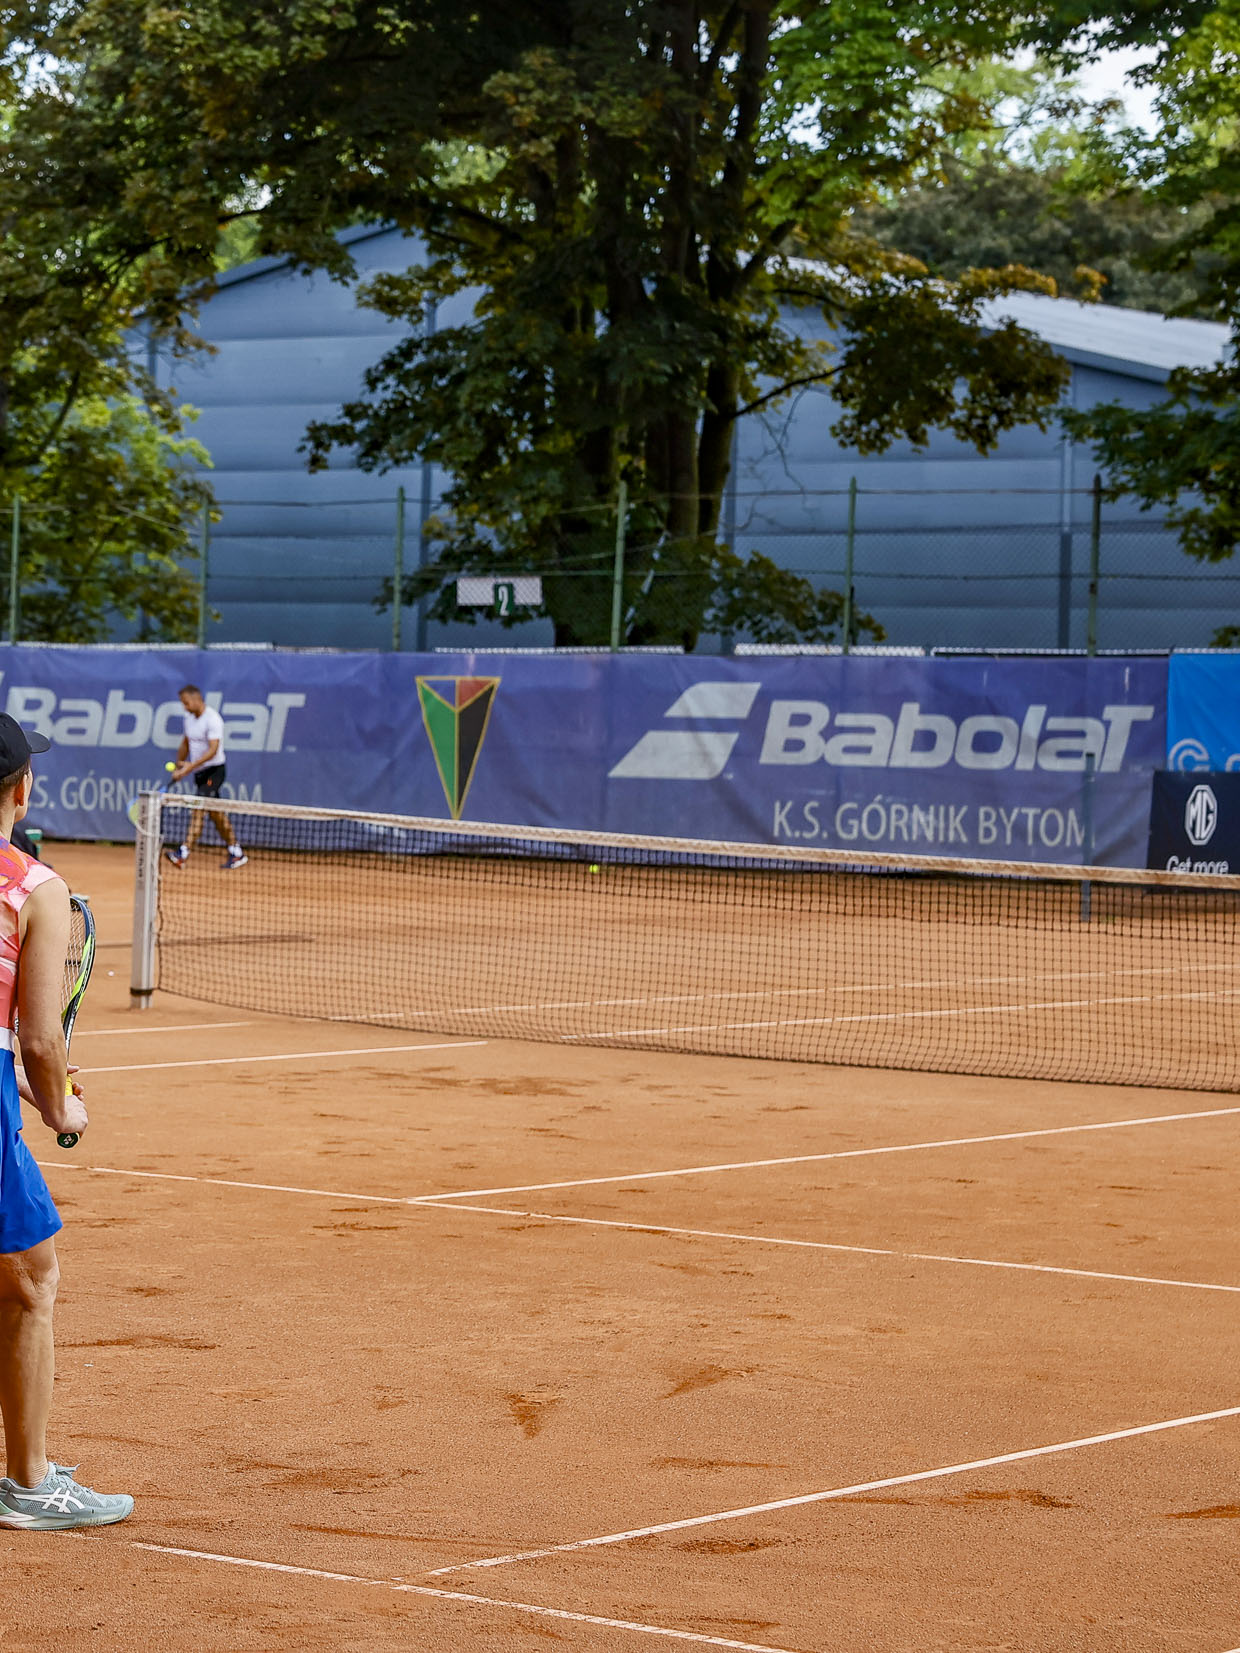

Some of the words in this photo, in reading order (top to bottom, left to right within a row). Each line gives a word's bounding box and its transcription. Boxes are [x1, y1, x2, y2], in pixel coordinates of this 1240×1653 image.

[498, 586, 509, 616] 2
[773, 800, 829, 839] K.S.
[835, 795, 968, 844] GÓRNIK
